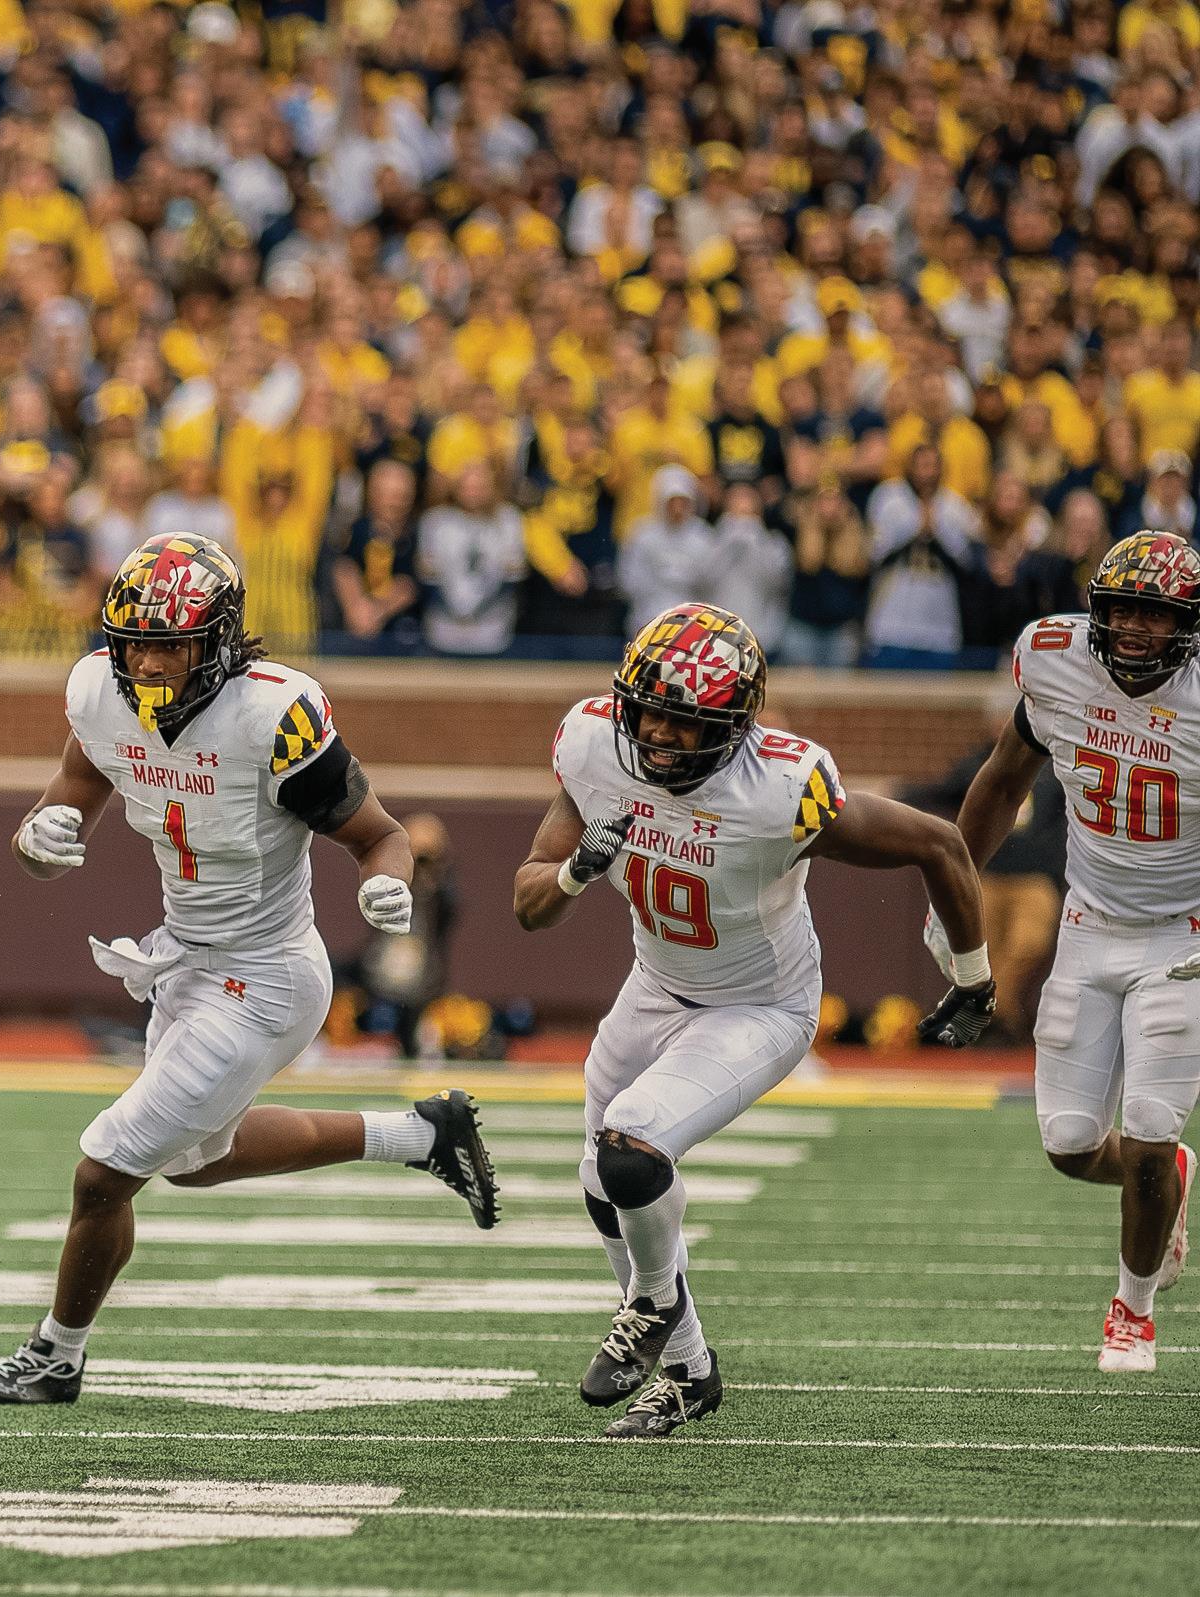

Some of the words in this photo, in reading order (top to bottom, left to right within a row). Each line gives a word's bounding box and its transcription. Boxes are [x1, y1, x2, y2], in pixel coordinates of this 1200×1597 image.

[138, 618, 150, 630] M
[655, 680, 668, 696] M
[756, 734, 811, 764] 19
[1086, 726, 1171, 763] MARYLAND
[132, 763, 215, 796] MARYLAND
[1072, 746, 1180, 844] 30
[163, 799, 199, 882] 1
[623, 851, 719, 950] 19
